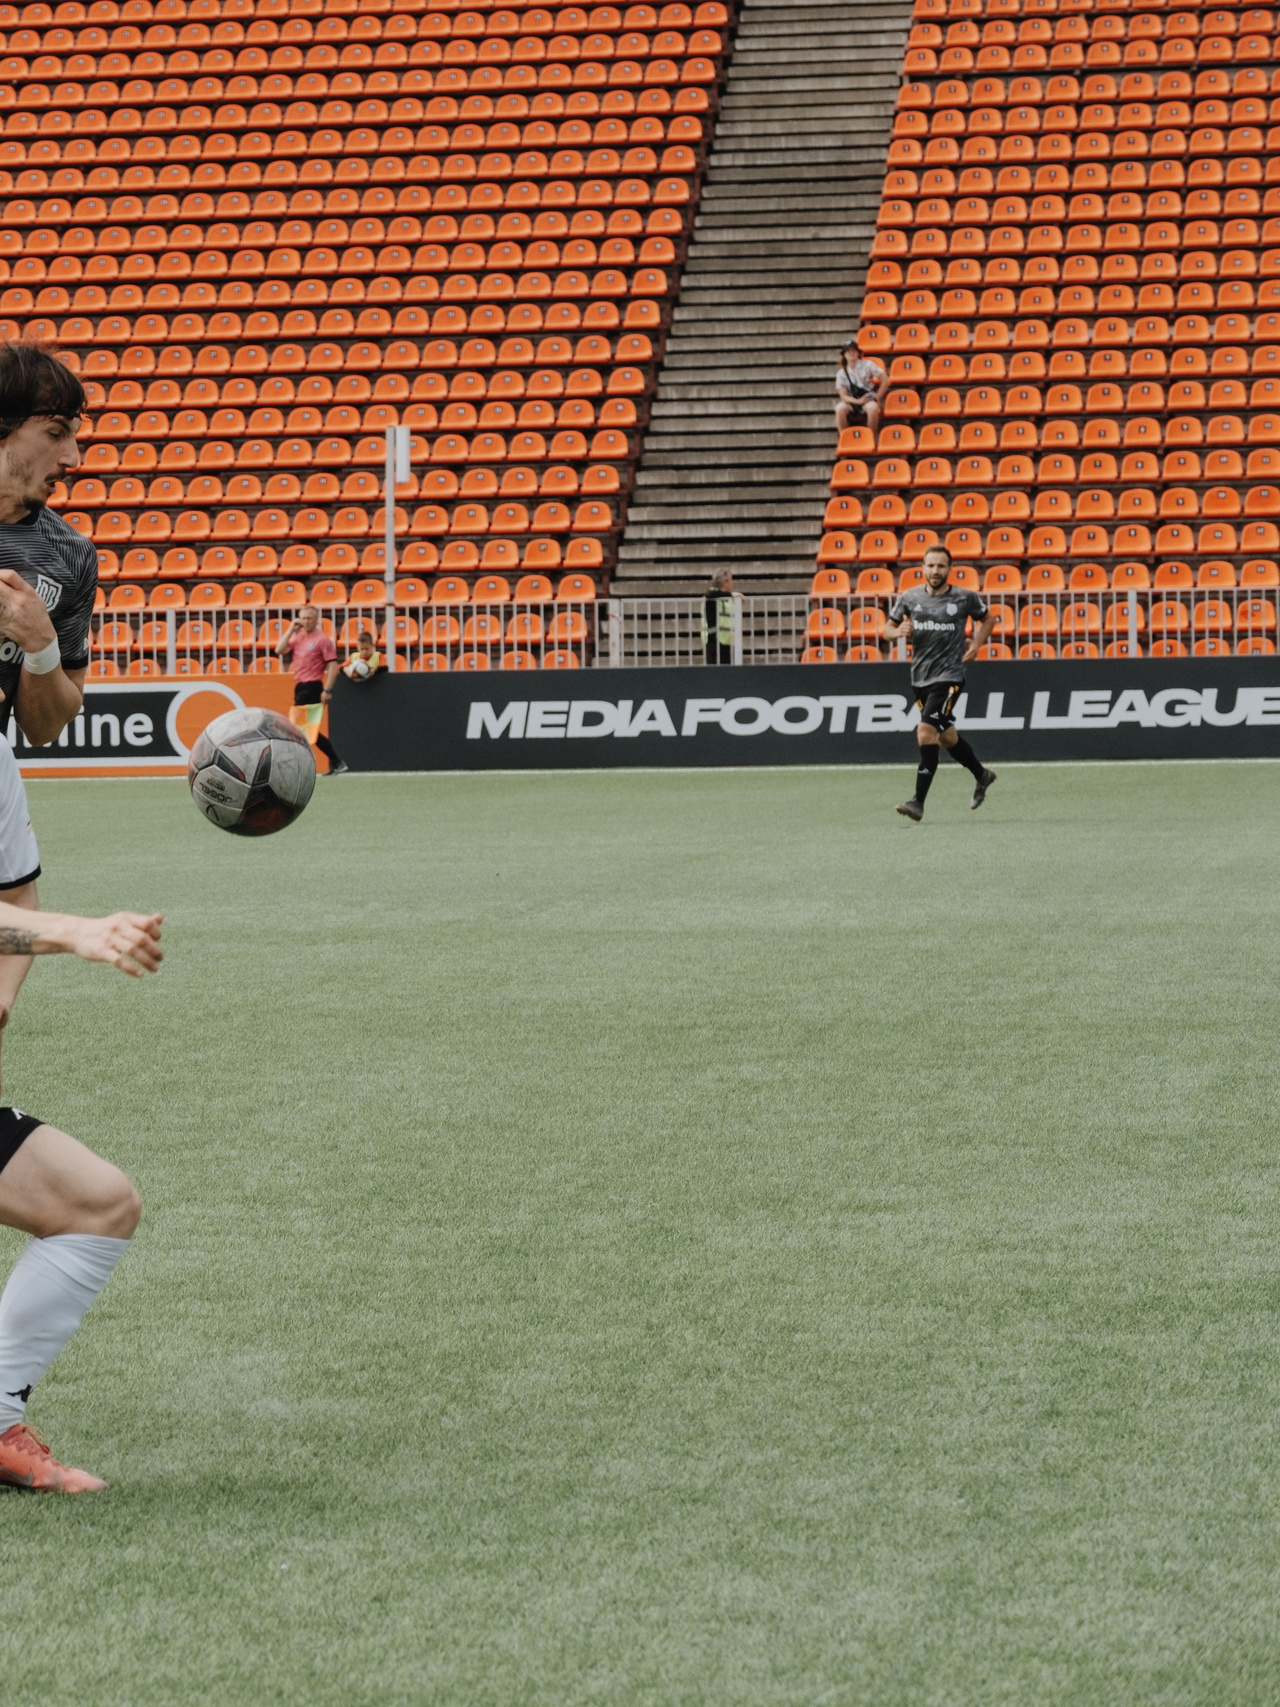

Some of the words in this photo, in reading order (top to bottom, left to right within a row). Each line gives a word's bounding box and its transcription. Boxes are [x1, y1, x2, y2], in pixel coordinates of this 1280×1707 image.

[466, 699, 677, 739] MEDIA
[681, 691, 1025, 736] FOOTBLL
[1029, 687, 1280, 729] LEAGUE
